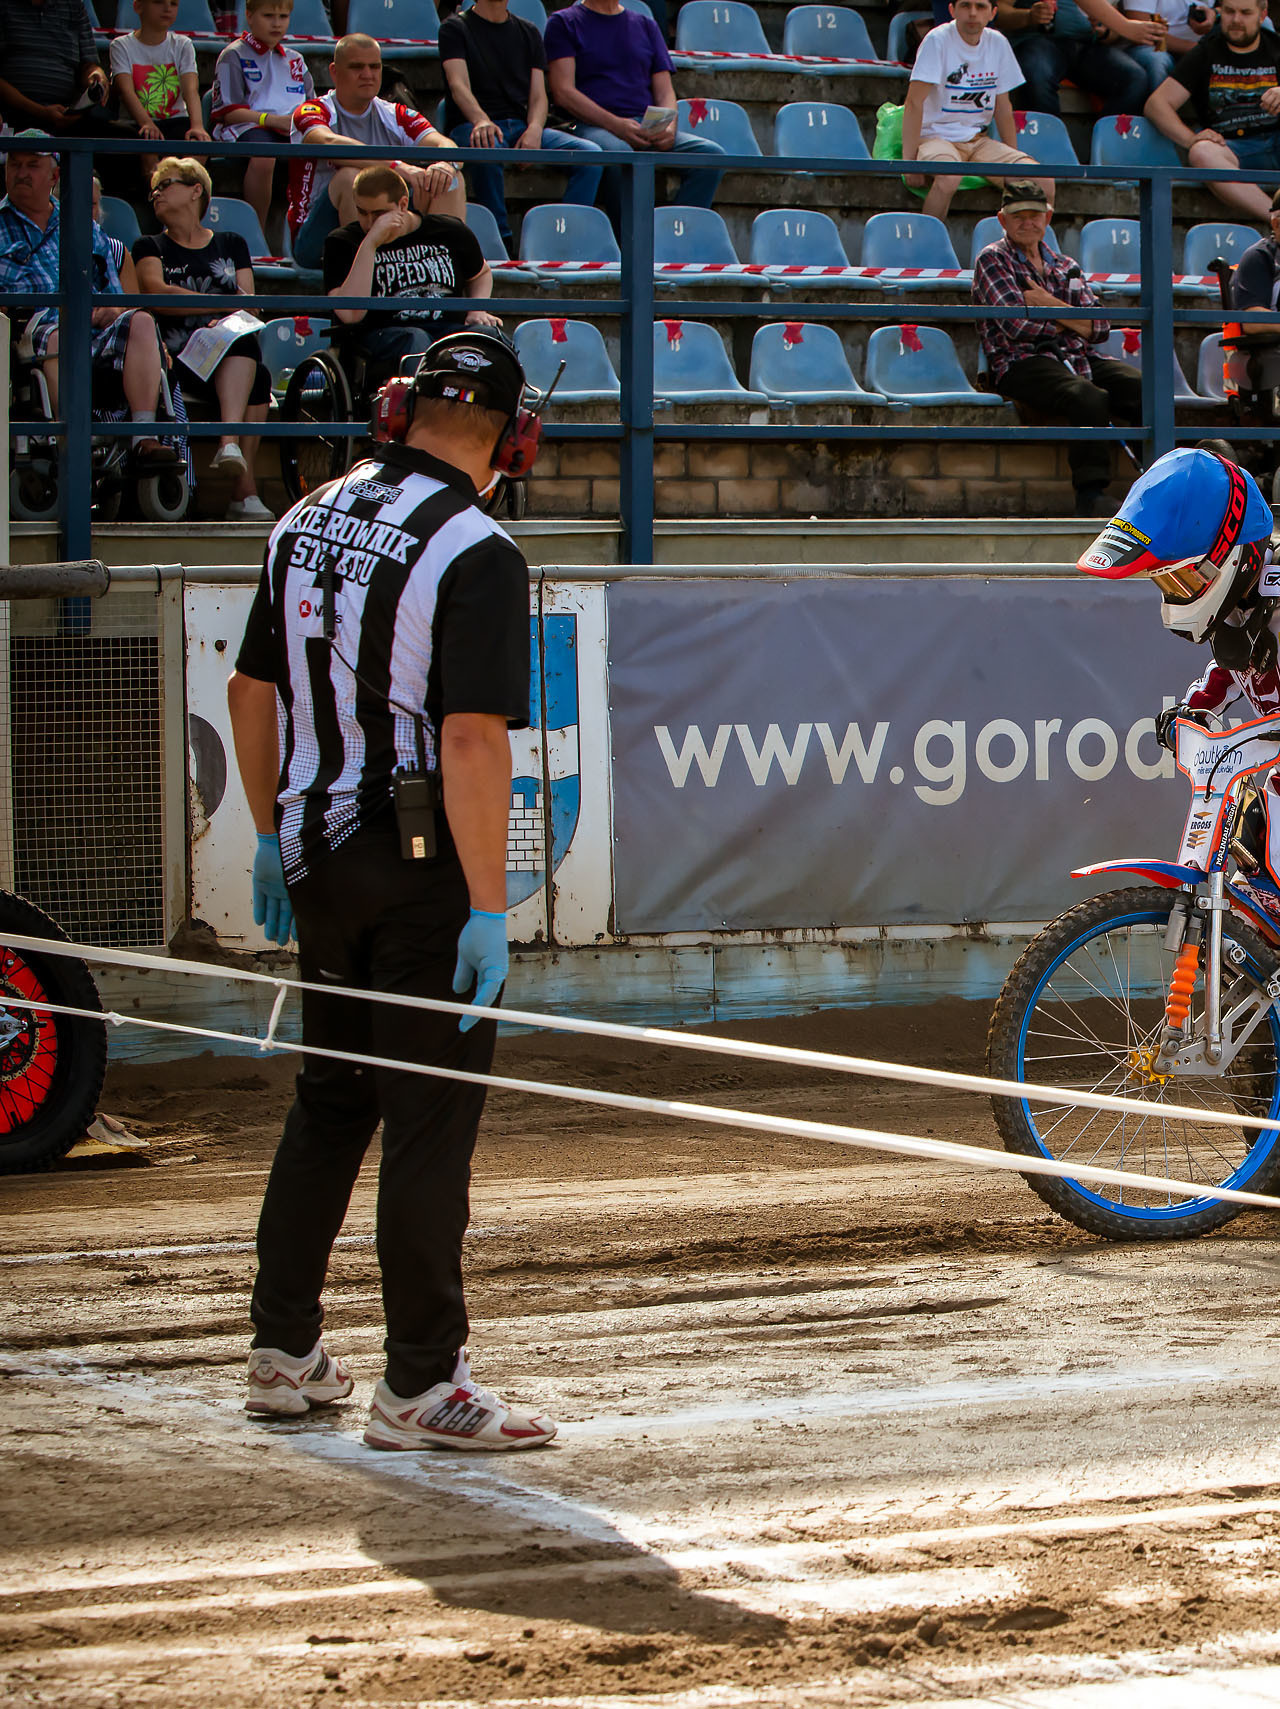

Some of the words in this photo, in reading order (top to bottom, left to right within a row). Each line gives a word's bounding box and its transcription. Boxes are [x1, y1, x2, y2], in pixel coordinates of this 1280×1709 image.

[713, 8, 730, 23] 11
[817, 13, 837, 29] 12
[1211, 64, 1278, 75] Volkswagen
[807, 110, 828, 127] 11
[210, 206, 219, 222] 5
[896, 224, 913, 239] 11
[1111, 229, 1131, 245] 13
[1215, 232, 1235, 248] 14
[375, 244, 449, 263] DAUGAVPILS
[376, 254, 456, 297] SPEEDWAY
[287, 506, 419, 565] KIEROWNIK
[1089, 554, 1106, 567] BELL
[1190, 820, 1212, 830] ERGOSS
